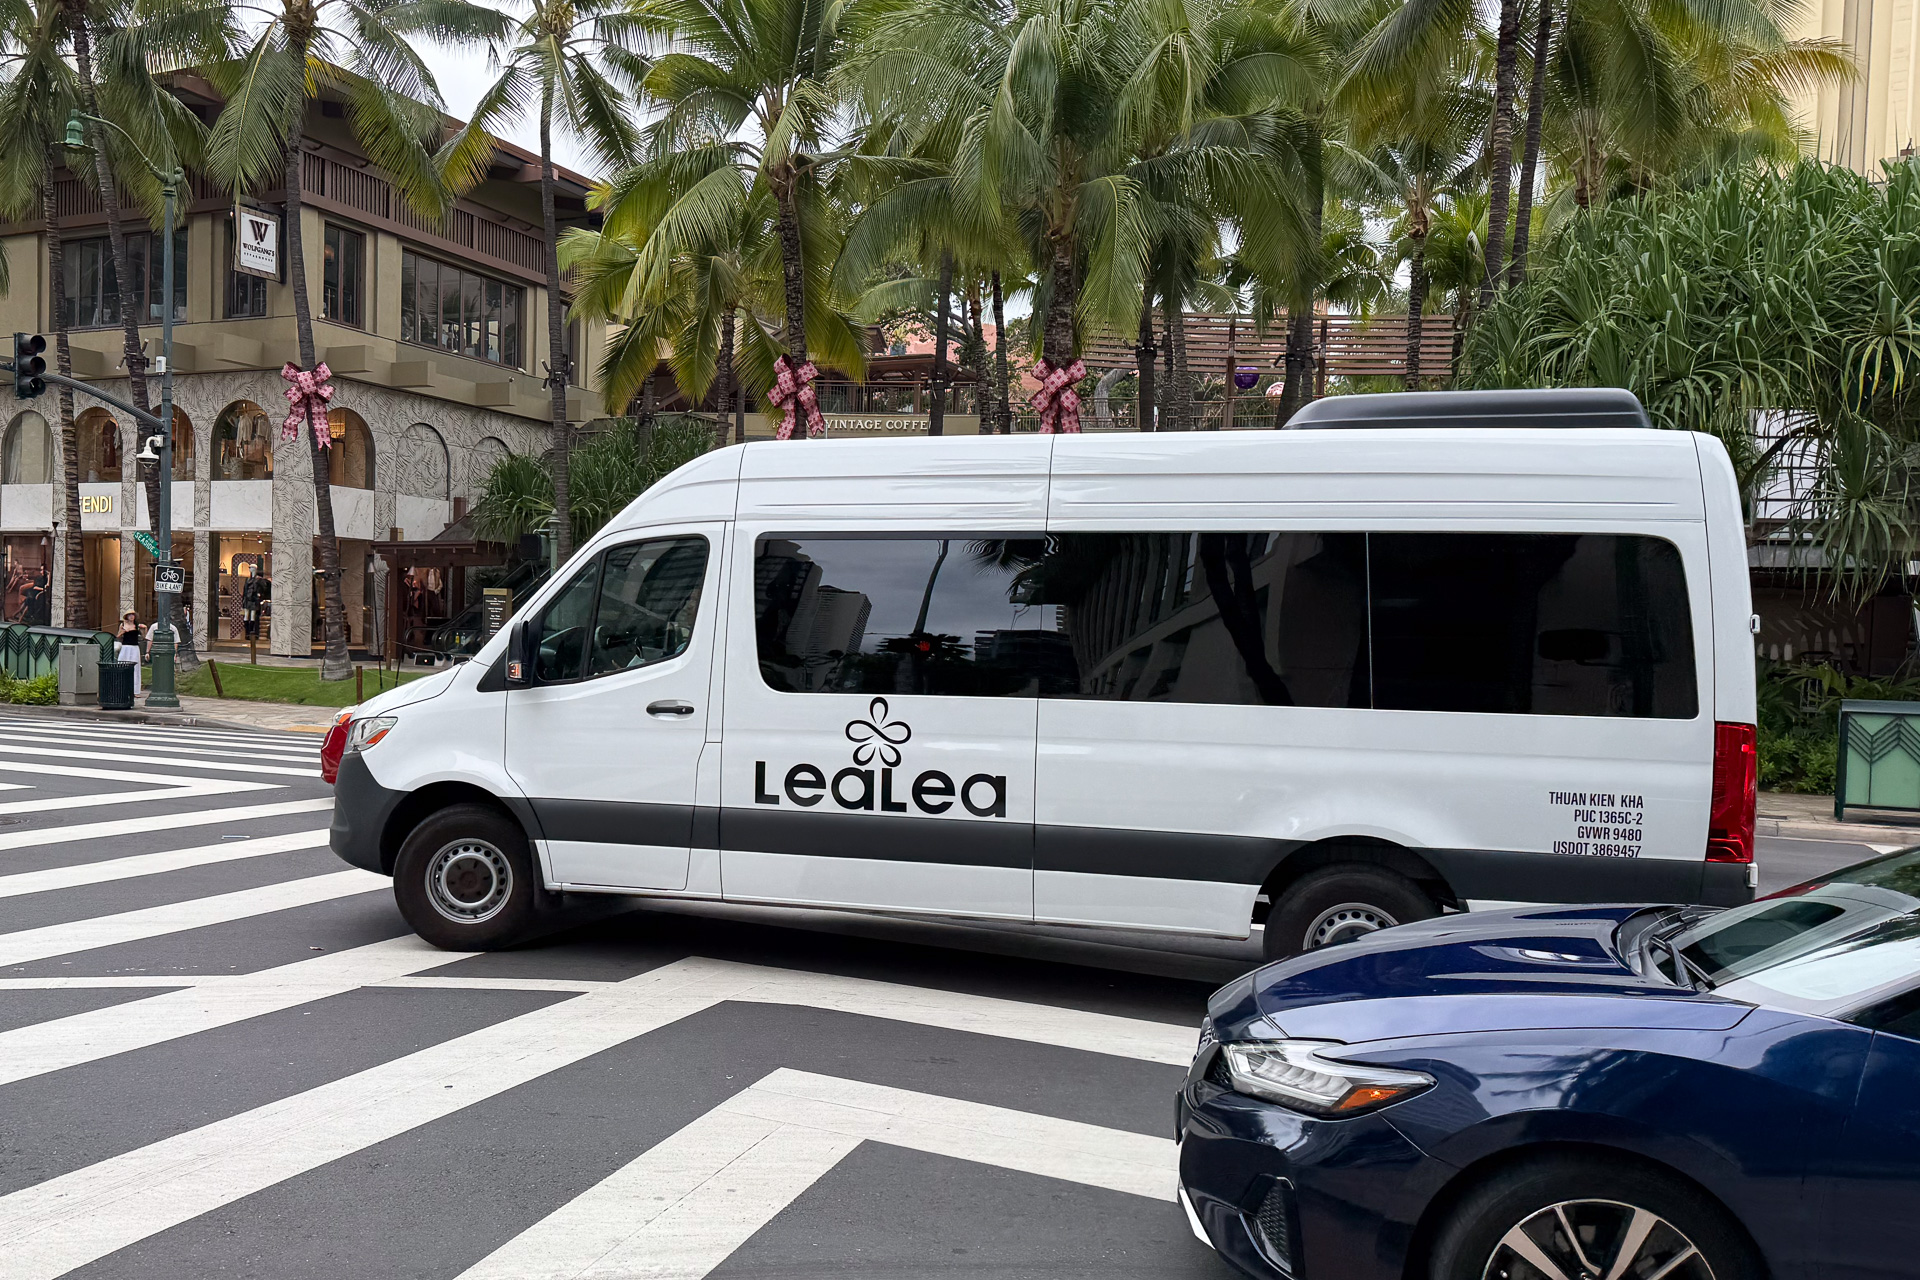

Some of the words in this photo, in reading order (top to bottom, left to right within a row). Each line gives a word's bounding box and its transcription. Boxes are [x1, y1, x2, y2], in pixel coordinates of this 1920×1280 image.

[249, 219, 269, 242] W
[825, 419, 882, 430] VINTAGE
[885, 419, 931, 430] COFFE
[134, 531, 156, 553] SEASIDE
[156, 582, 168, 590] BIKE
[1549, 791, 1587, 806] THUAN
[1589, 793, 1615, 807] KIEN
[1620, 794, 1644, 809] KHA
[1574, 809, 1597, 823] PUC
[1598, 811, 1643, 825] 1365C-2
[1577, 825, 1610, 840] GVWR
[1612, 827, 1642, 842] 9480
[1553, 840, 1590, 855] USDOT
[1591, 843, 1642, 858] 3869457
